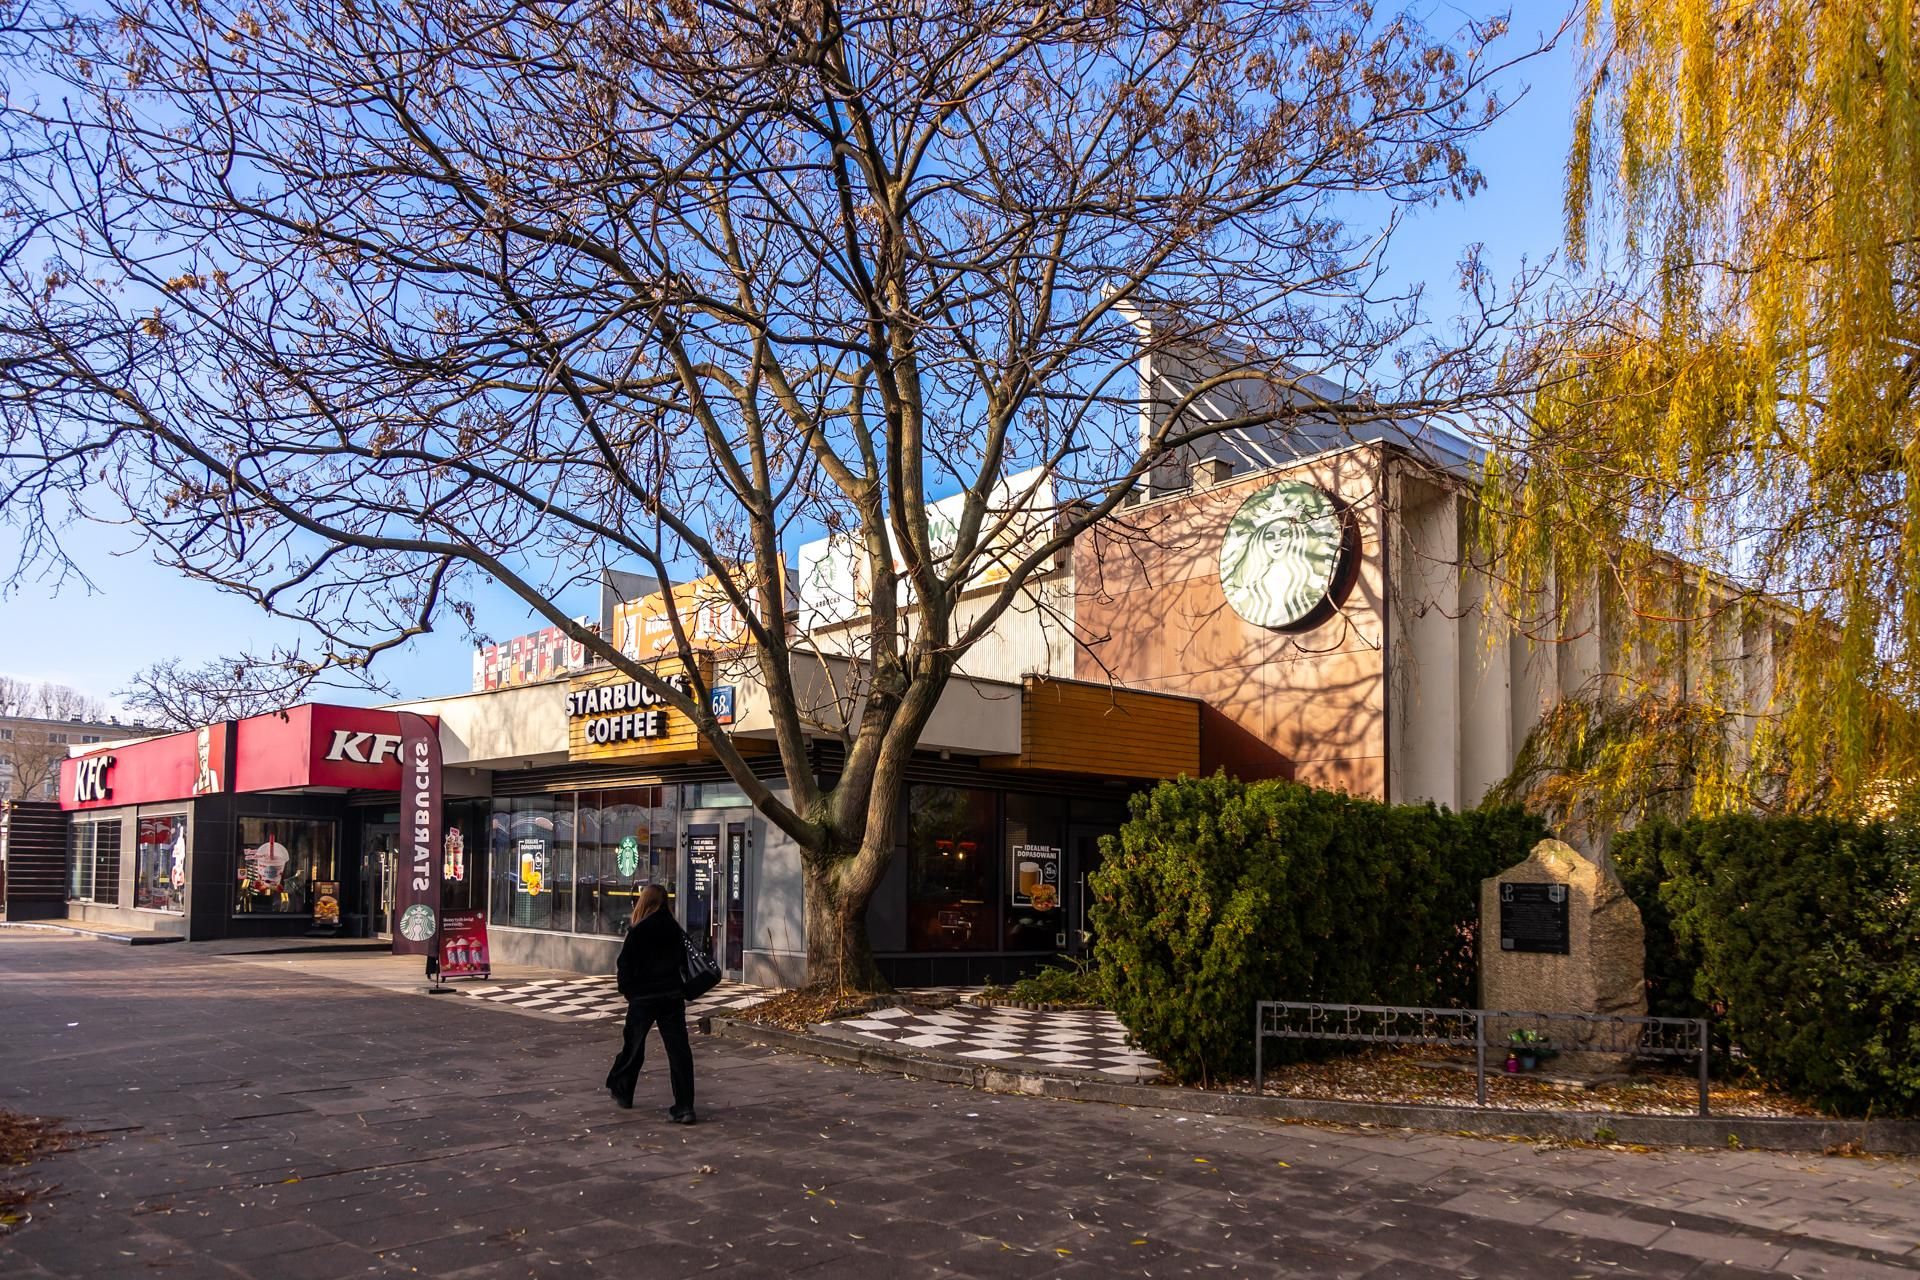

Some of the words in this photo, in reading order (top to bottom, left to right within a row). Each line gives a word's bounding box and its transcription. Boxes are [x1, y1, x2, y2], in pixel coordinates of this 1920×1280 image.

[712, 694, 730, 716] 68A
[584, 710, 658, 744] COFFEE
[325, 730, 404, 764] KF
[73, 756, 107, 801] KFC
[1018, 851, 1057, 859] DOPASOWANI
